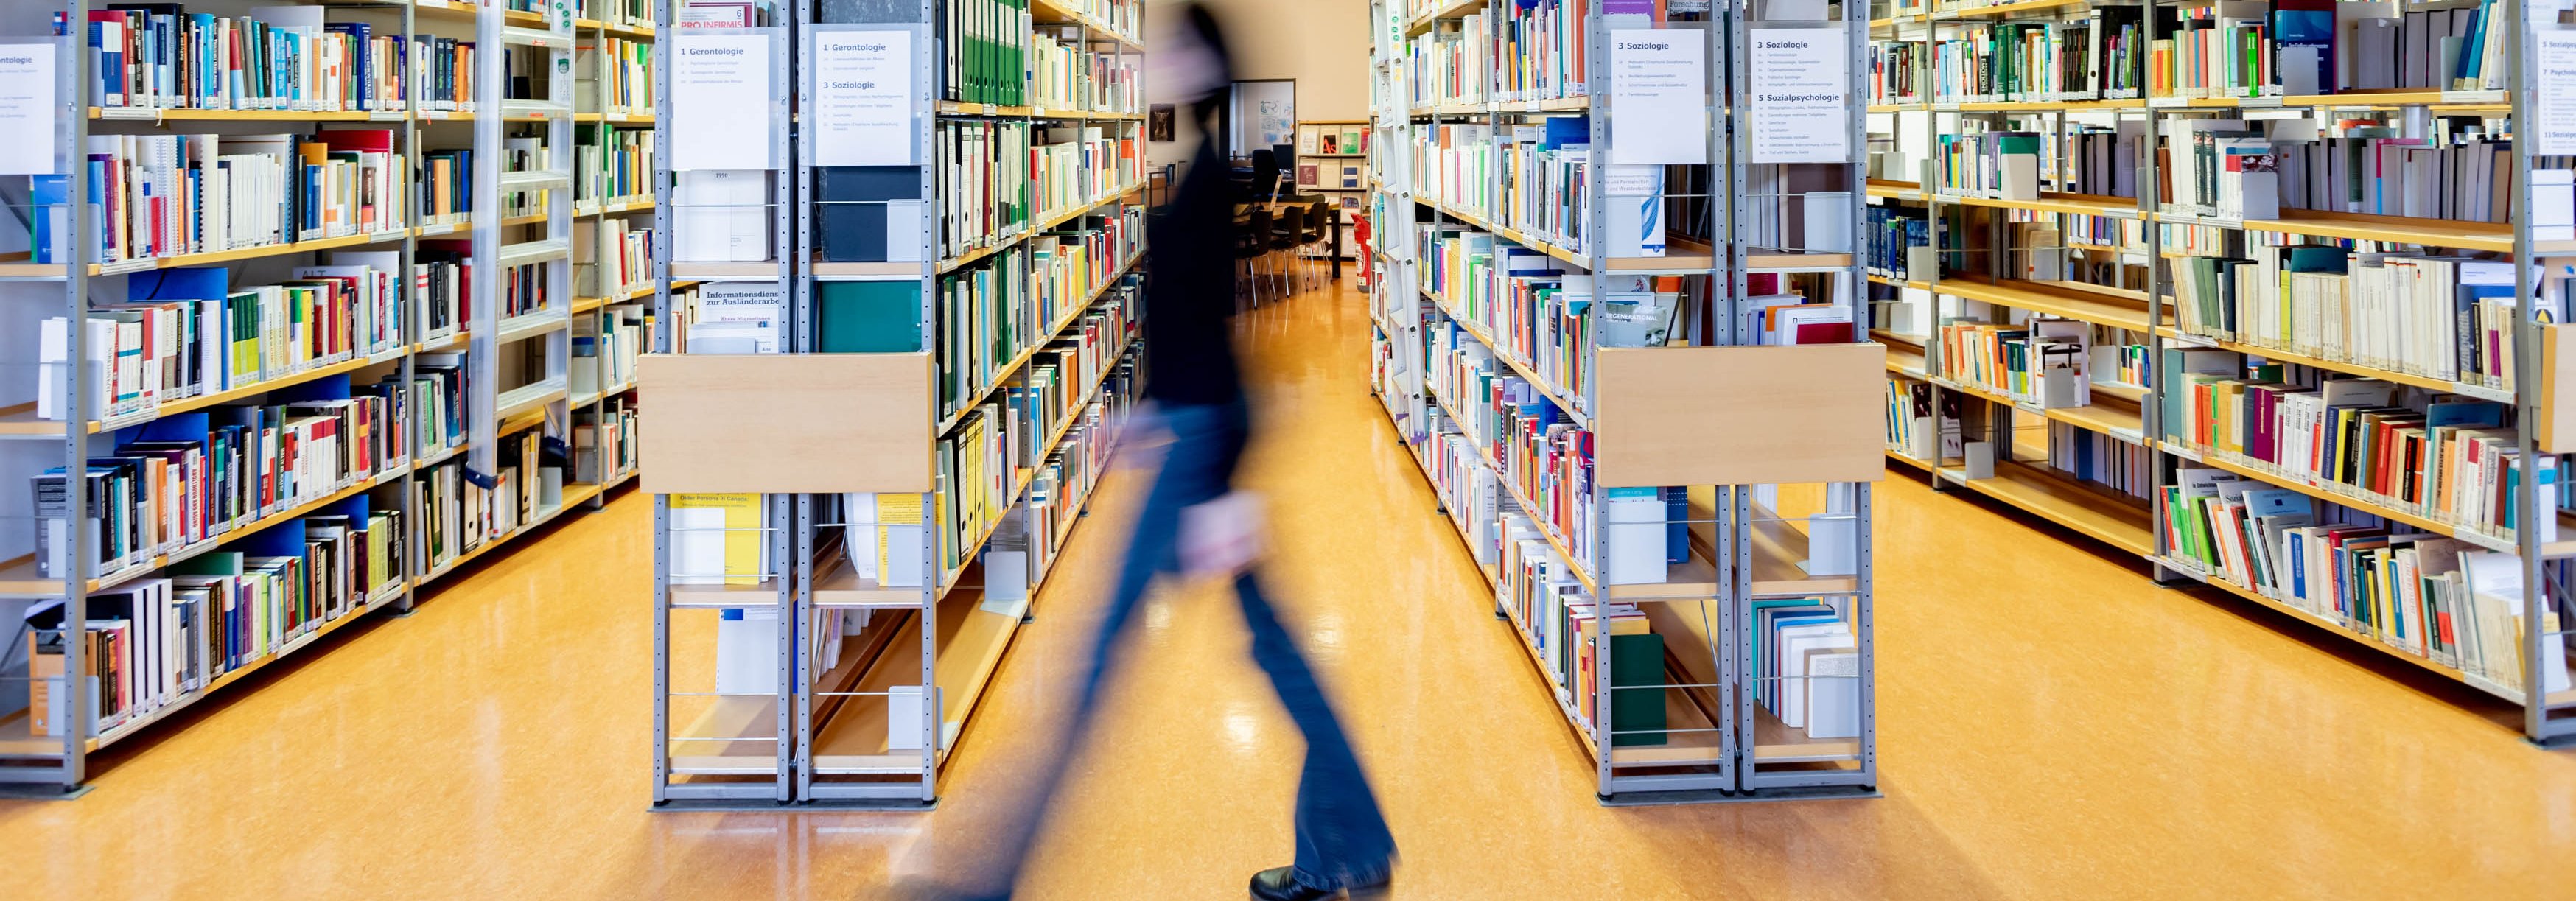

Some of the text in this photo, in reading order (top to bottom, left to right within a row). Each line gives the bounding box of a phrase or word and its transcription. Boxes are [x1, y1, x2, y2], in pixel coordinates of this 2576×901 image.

[832, 43, 886, 52] Gerontologie
[1627, 42, 1669, 50] Soziologie
[1766, 41, 1808, 49] Soziologie
[690, 48, 743, 56] Gerontologie
[832, 81, 875, 90] Soziologie
[1767, 94, 1840, 102] Sozialpsychologie
